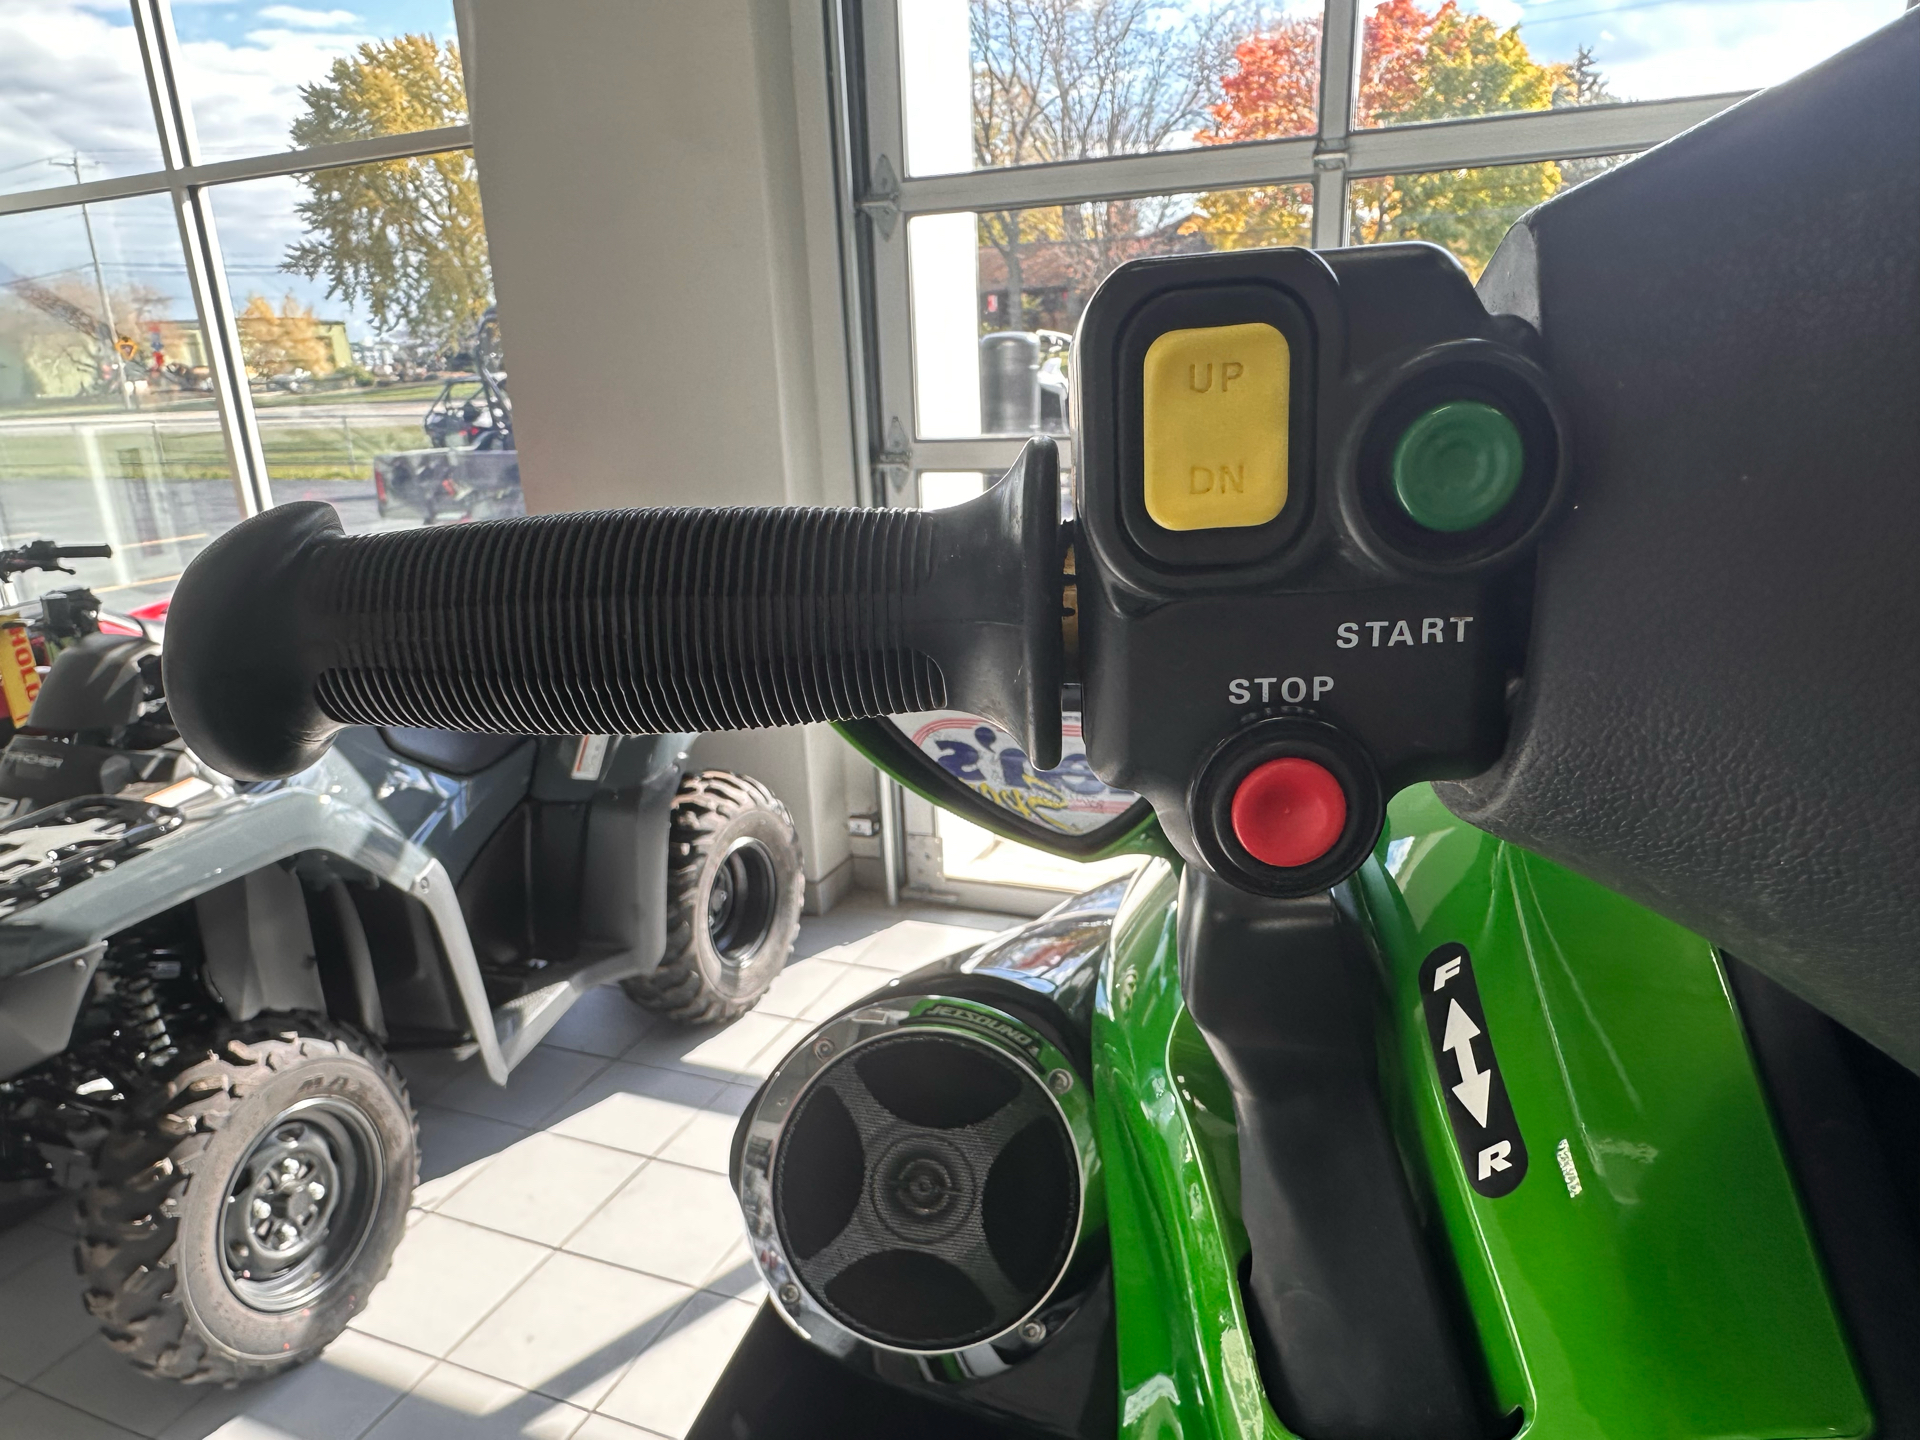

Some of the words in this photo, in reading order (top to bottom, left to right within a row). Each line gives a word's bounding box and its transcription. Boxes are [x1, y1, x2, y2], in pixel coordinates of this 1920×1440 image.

[1189, 362, 1244, 393] UP
[1189, 465, 1244, 494] DN
[1336, 616, 1474, 649] START
[1228, 675, 1335, 705] STOP
[1433, 955, 1462, 992] F
[924, 1004, 1034, 1047] JETSOUND
[1477, 1139, 1513, 1182] R
